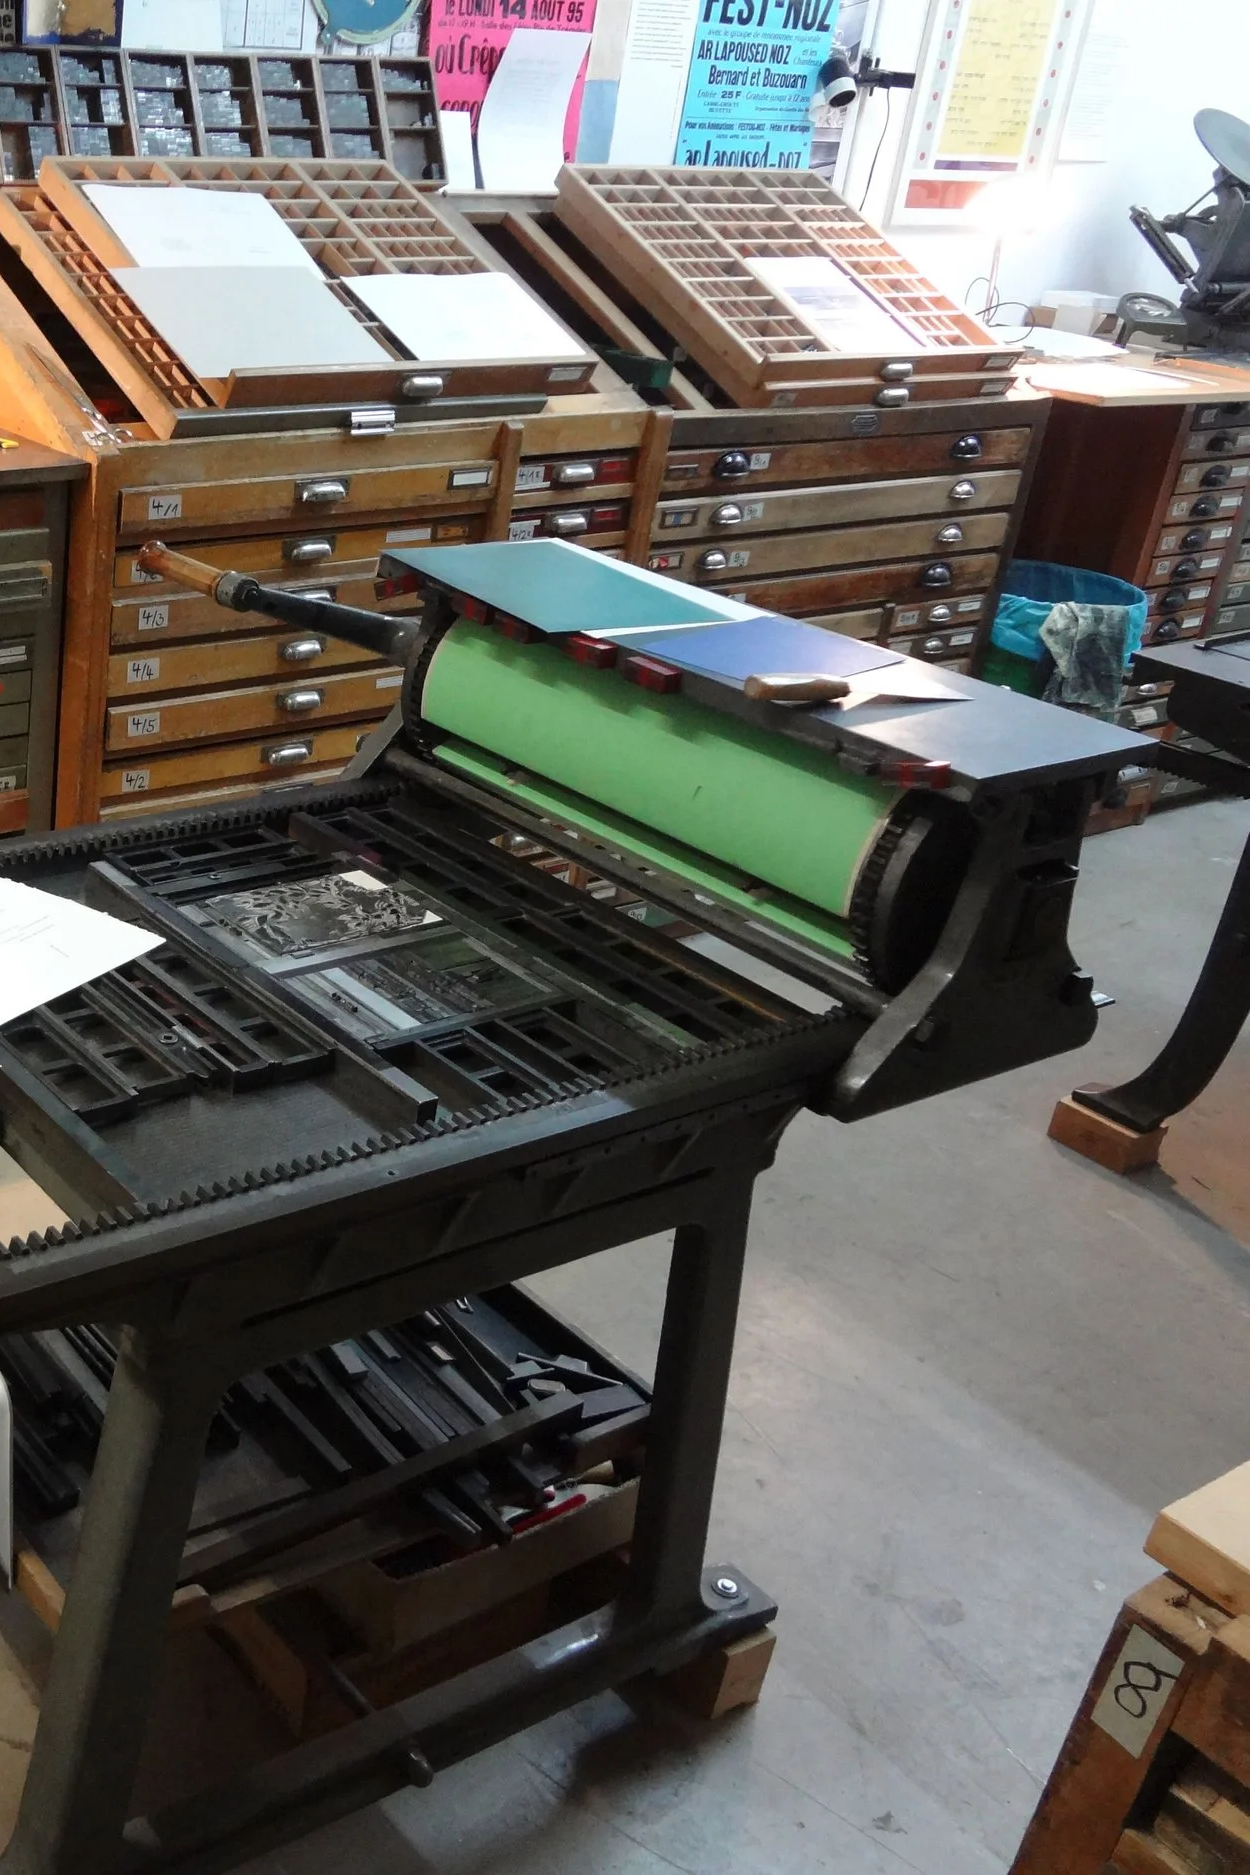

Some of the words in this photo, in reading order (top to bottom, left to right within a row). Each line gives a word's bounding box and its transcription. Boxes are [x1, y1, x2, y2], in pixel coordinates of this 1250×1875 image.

[445, 0, 455, 15] le
[458, 0, 495, 17] LUNDI
[499, 0, 526, 19] 14
[567, 1, 585, 23] 95
[703, 0, 834, 32] FEST-NOZ
[729, 30, 752, 39] groupe
[697, 40, 713, 60] AR
[714, 41, 768, 64] LAPOUSED
[769, 45, 792, 65] NOZ
[708, 65, 749, 87] Bernard
[750, 70, 760, 87] et
[762, 67, 808, 89] Buzouarn
[720, 91, 734, 99] 25
[735, 91, 743, 99] F
[684, 120, 697, 130] Pour
[152, 498, 180, 519] 4/1
[141, 608, 166, 628] 4/3
[132, 662, 155, 681] 4/4
[132, 716, 157, 734] 4/5
[126, 772, 146, 790] 4/2
